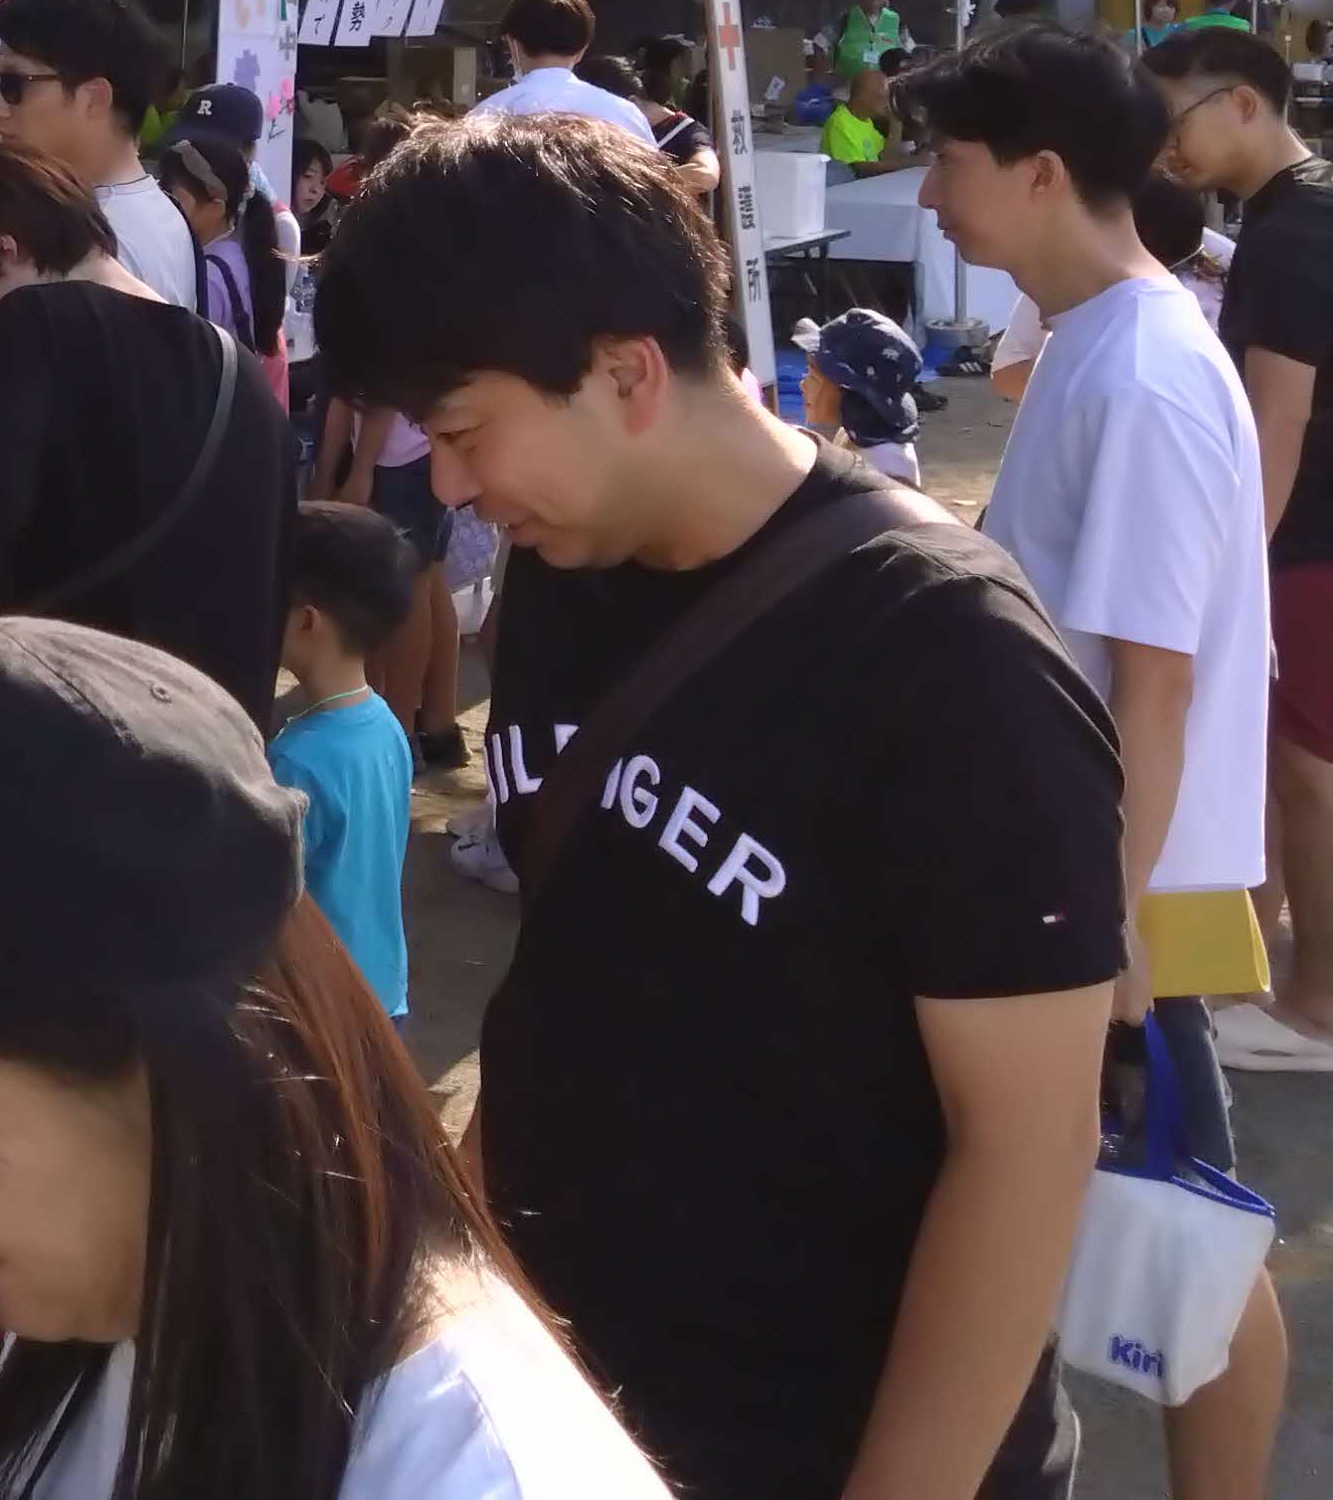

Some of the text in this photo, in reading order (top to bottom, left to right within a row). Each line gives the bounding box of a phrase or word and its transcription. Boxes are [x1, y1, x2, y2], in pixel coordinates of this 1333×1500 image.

[197, 100, 212, 116] R
[483, 723, 787, 927] ILIGER
[1110, 1334, 1165, 1378] Kiri
